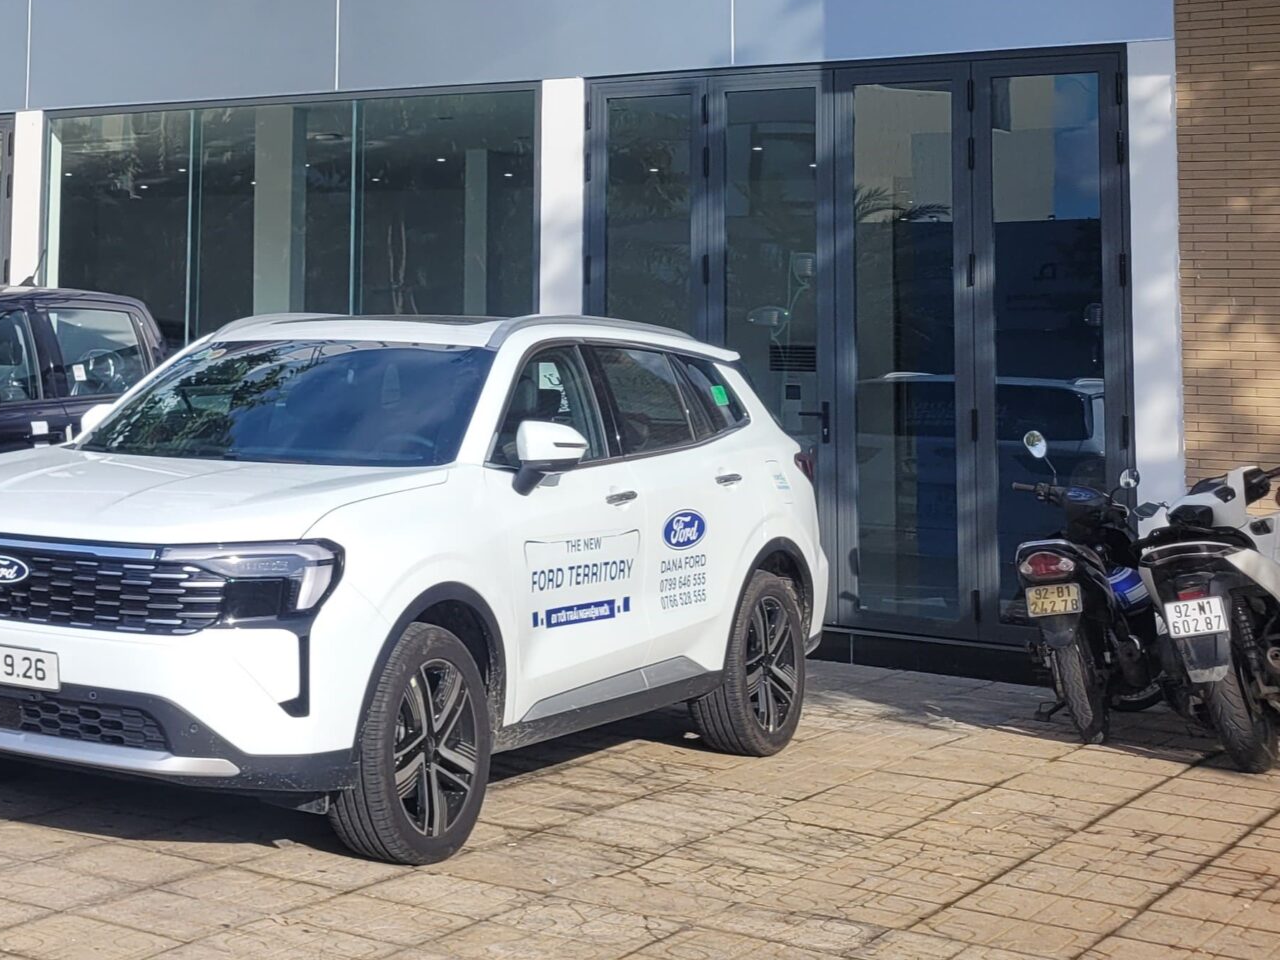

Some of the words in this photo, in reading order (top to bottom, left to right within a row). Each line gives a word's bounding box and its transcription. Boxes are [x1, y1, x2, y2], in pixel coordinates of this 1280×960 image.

[670, 515, 699, 544] Ford
[566, 538, 582, 553] THE
[583, 537, 602, 551] NEW
[660, 557, 683, 574] DANA
[684, 553, 707, 570] FORD
[531, 567, 565, 593] FORD
[568, 558, 634, 587] TERRITORY
[678, 574, 691, 589] 646
[692, 572, 706, 587] 555
[693, 588, 707, 603] 555
[1173, 600, 1213, 619] 92-N1
[1172, 614, 1222, 635] 602.87
